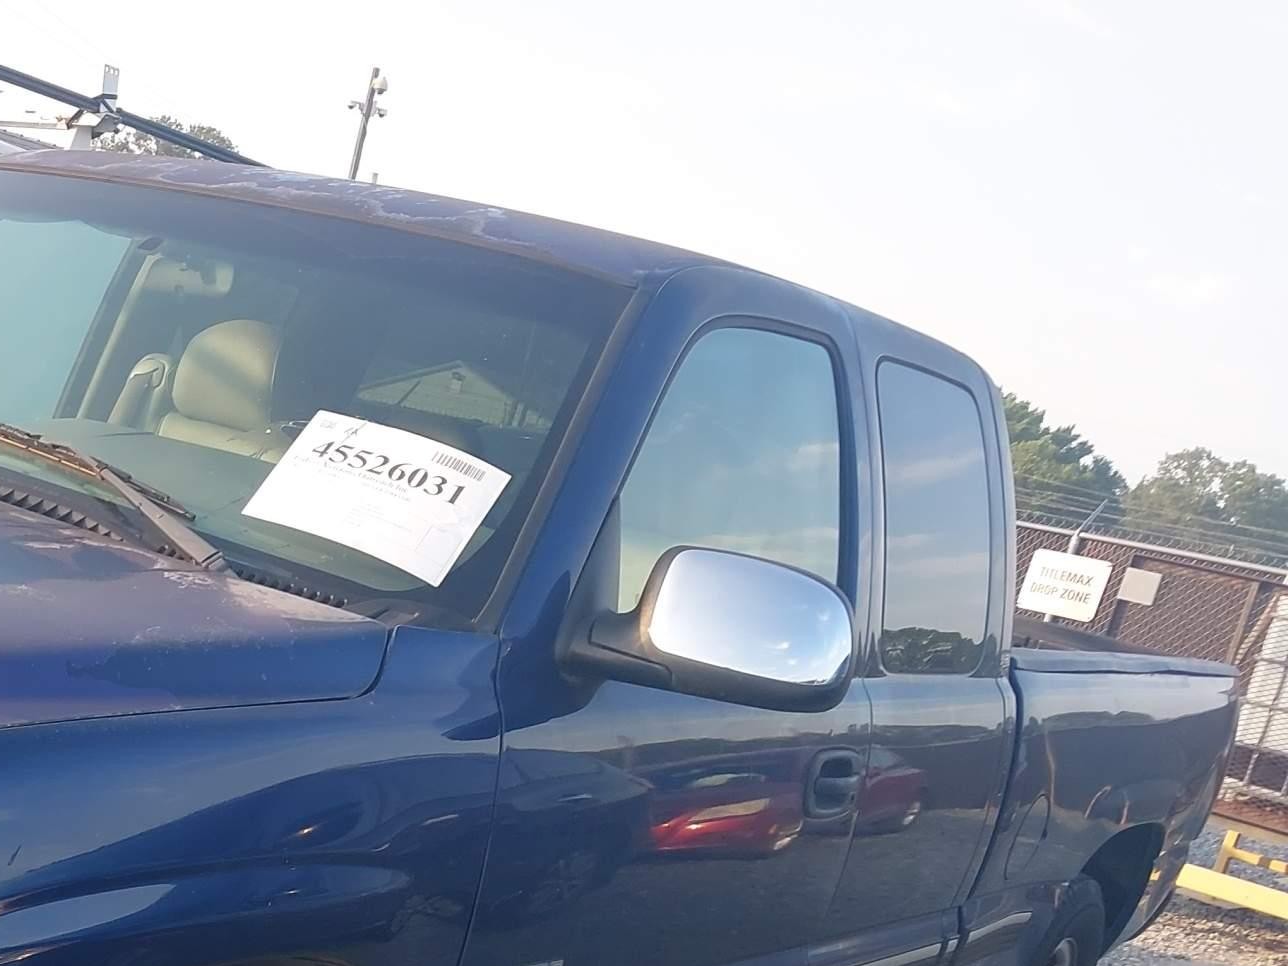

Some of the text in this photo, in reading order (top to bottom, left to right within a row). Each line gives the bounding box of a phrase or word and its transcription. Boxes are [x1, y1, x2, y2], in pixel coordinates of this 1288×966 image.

[312, 440, 466, 505] 45526031
[1040, 566, 1094, 587] TITLEMAX
[1030, 582, 1092, 604] DROP ZONE
